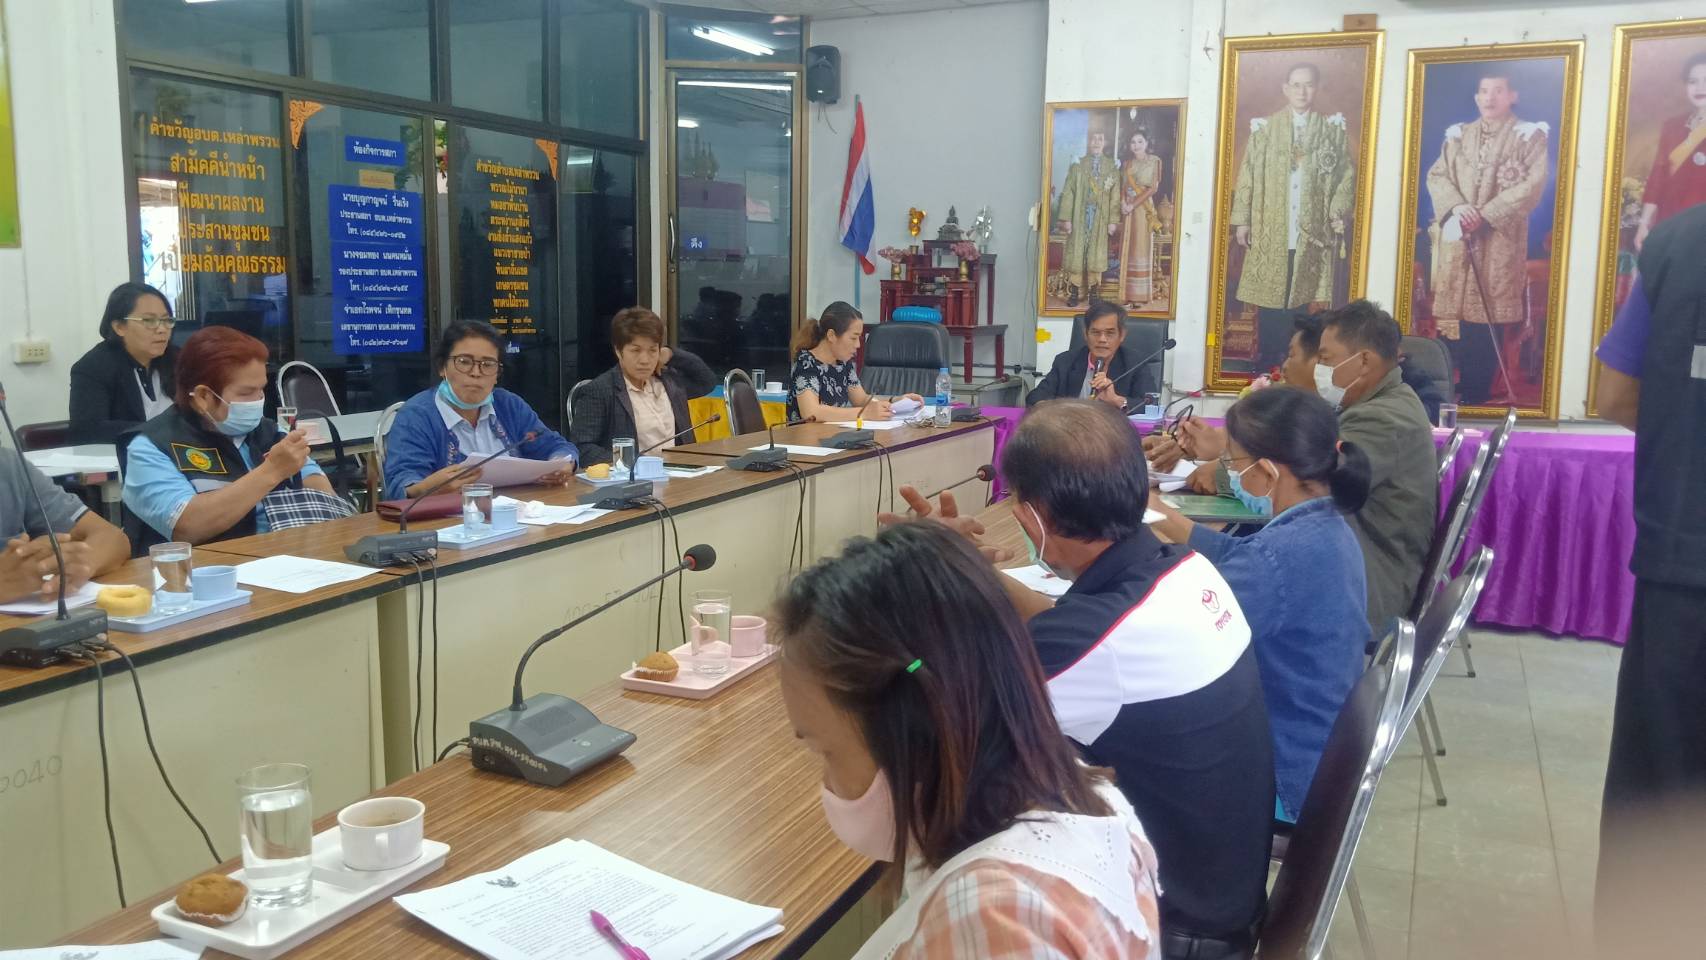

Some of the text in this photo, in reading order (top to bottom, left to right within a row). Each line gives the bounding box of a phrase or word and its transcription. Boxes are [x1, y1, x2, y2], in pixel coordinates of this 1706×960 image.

[170, 149, 265, 181] สามัคคีนำหน้า
[179, 181, 264, 213] พัฒนาผลงาน
